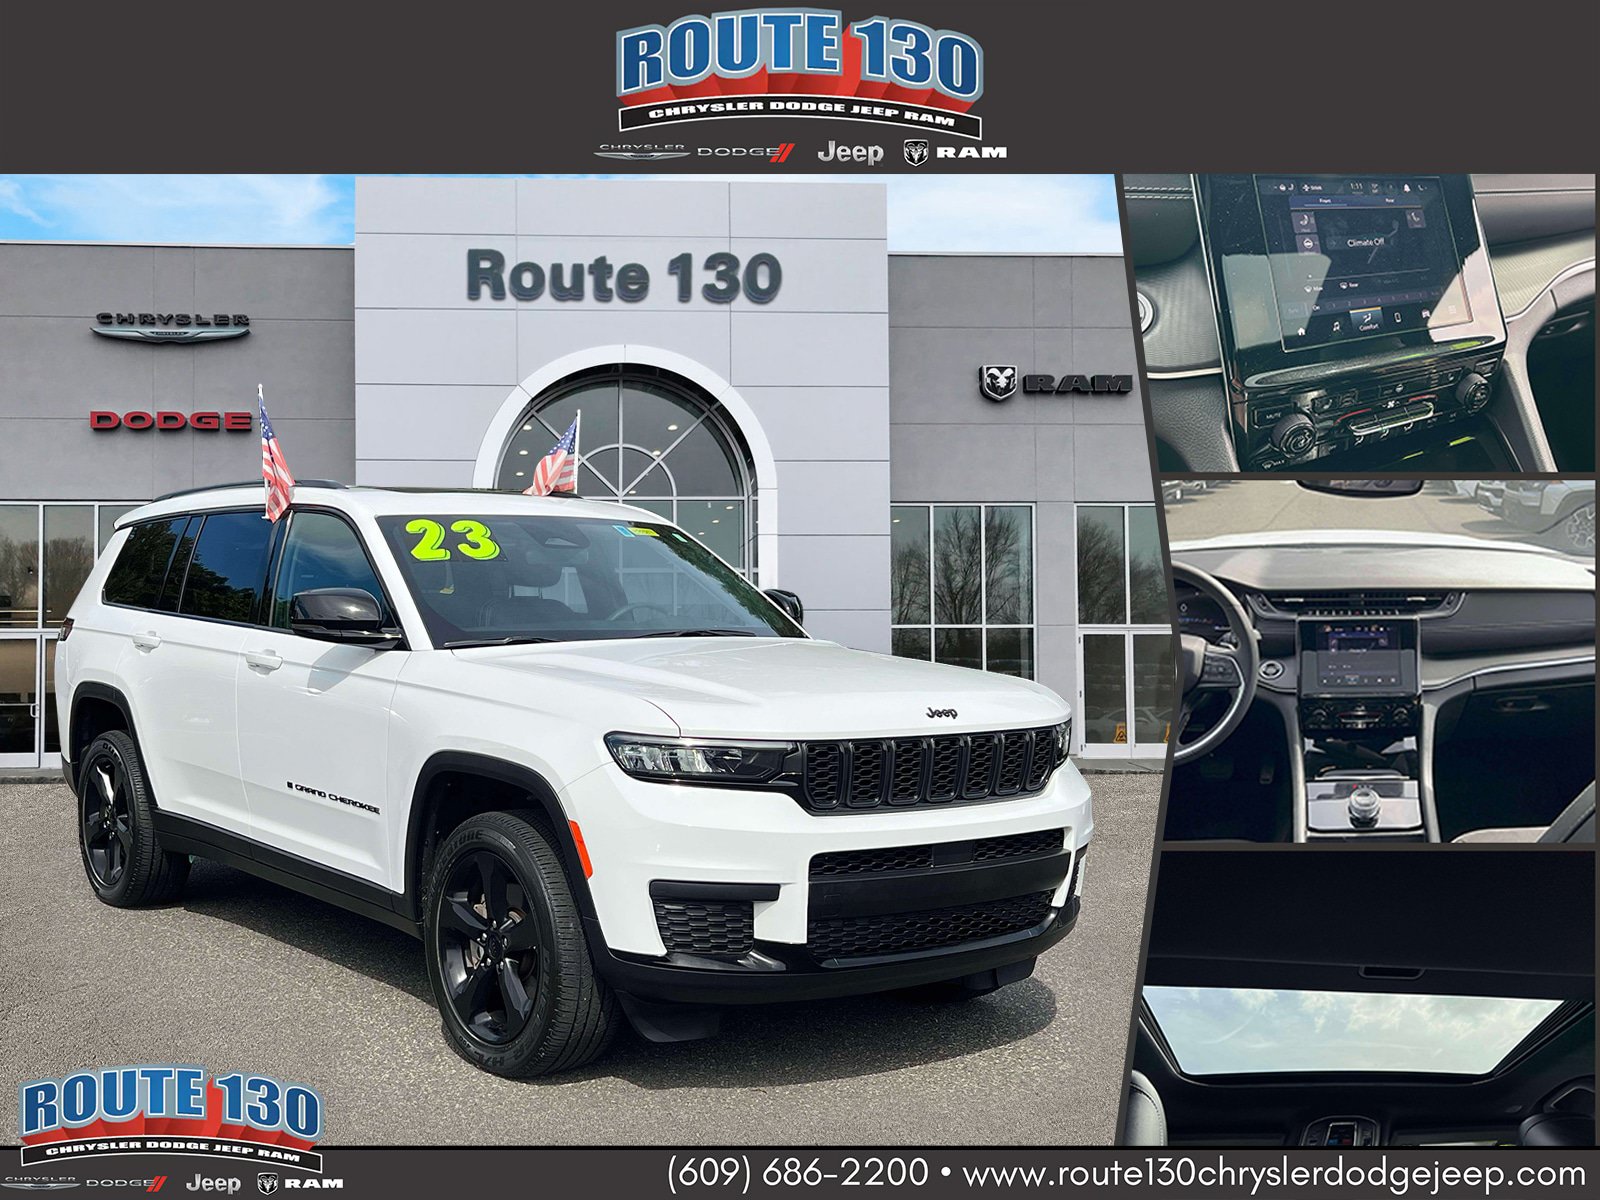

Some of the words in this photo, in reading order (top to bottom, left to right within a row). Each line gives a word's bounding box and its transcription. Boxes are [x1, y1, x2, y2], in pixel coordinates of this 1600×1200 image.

[1347, 239, 1374, 248] Climate
[1373, 237, 1385, 246] Off
[467, 248, 650, 303] Route
[667, 251, 783, 305] 130
[95, 312, 250, 326] CHRYSLER
[1359, 323, 1379, 331] Comfort
[1022, 374, 1133, 394] RAM
[89, 411, 252, 431] DODGE
[405, 518, 501, 562] 23
[926, 706, 959, 720] Jeep
[294, 784, 326, 799] GRAND
[328, 793, 381, 815] CHEROKEE
